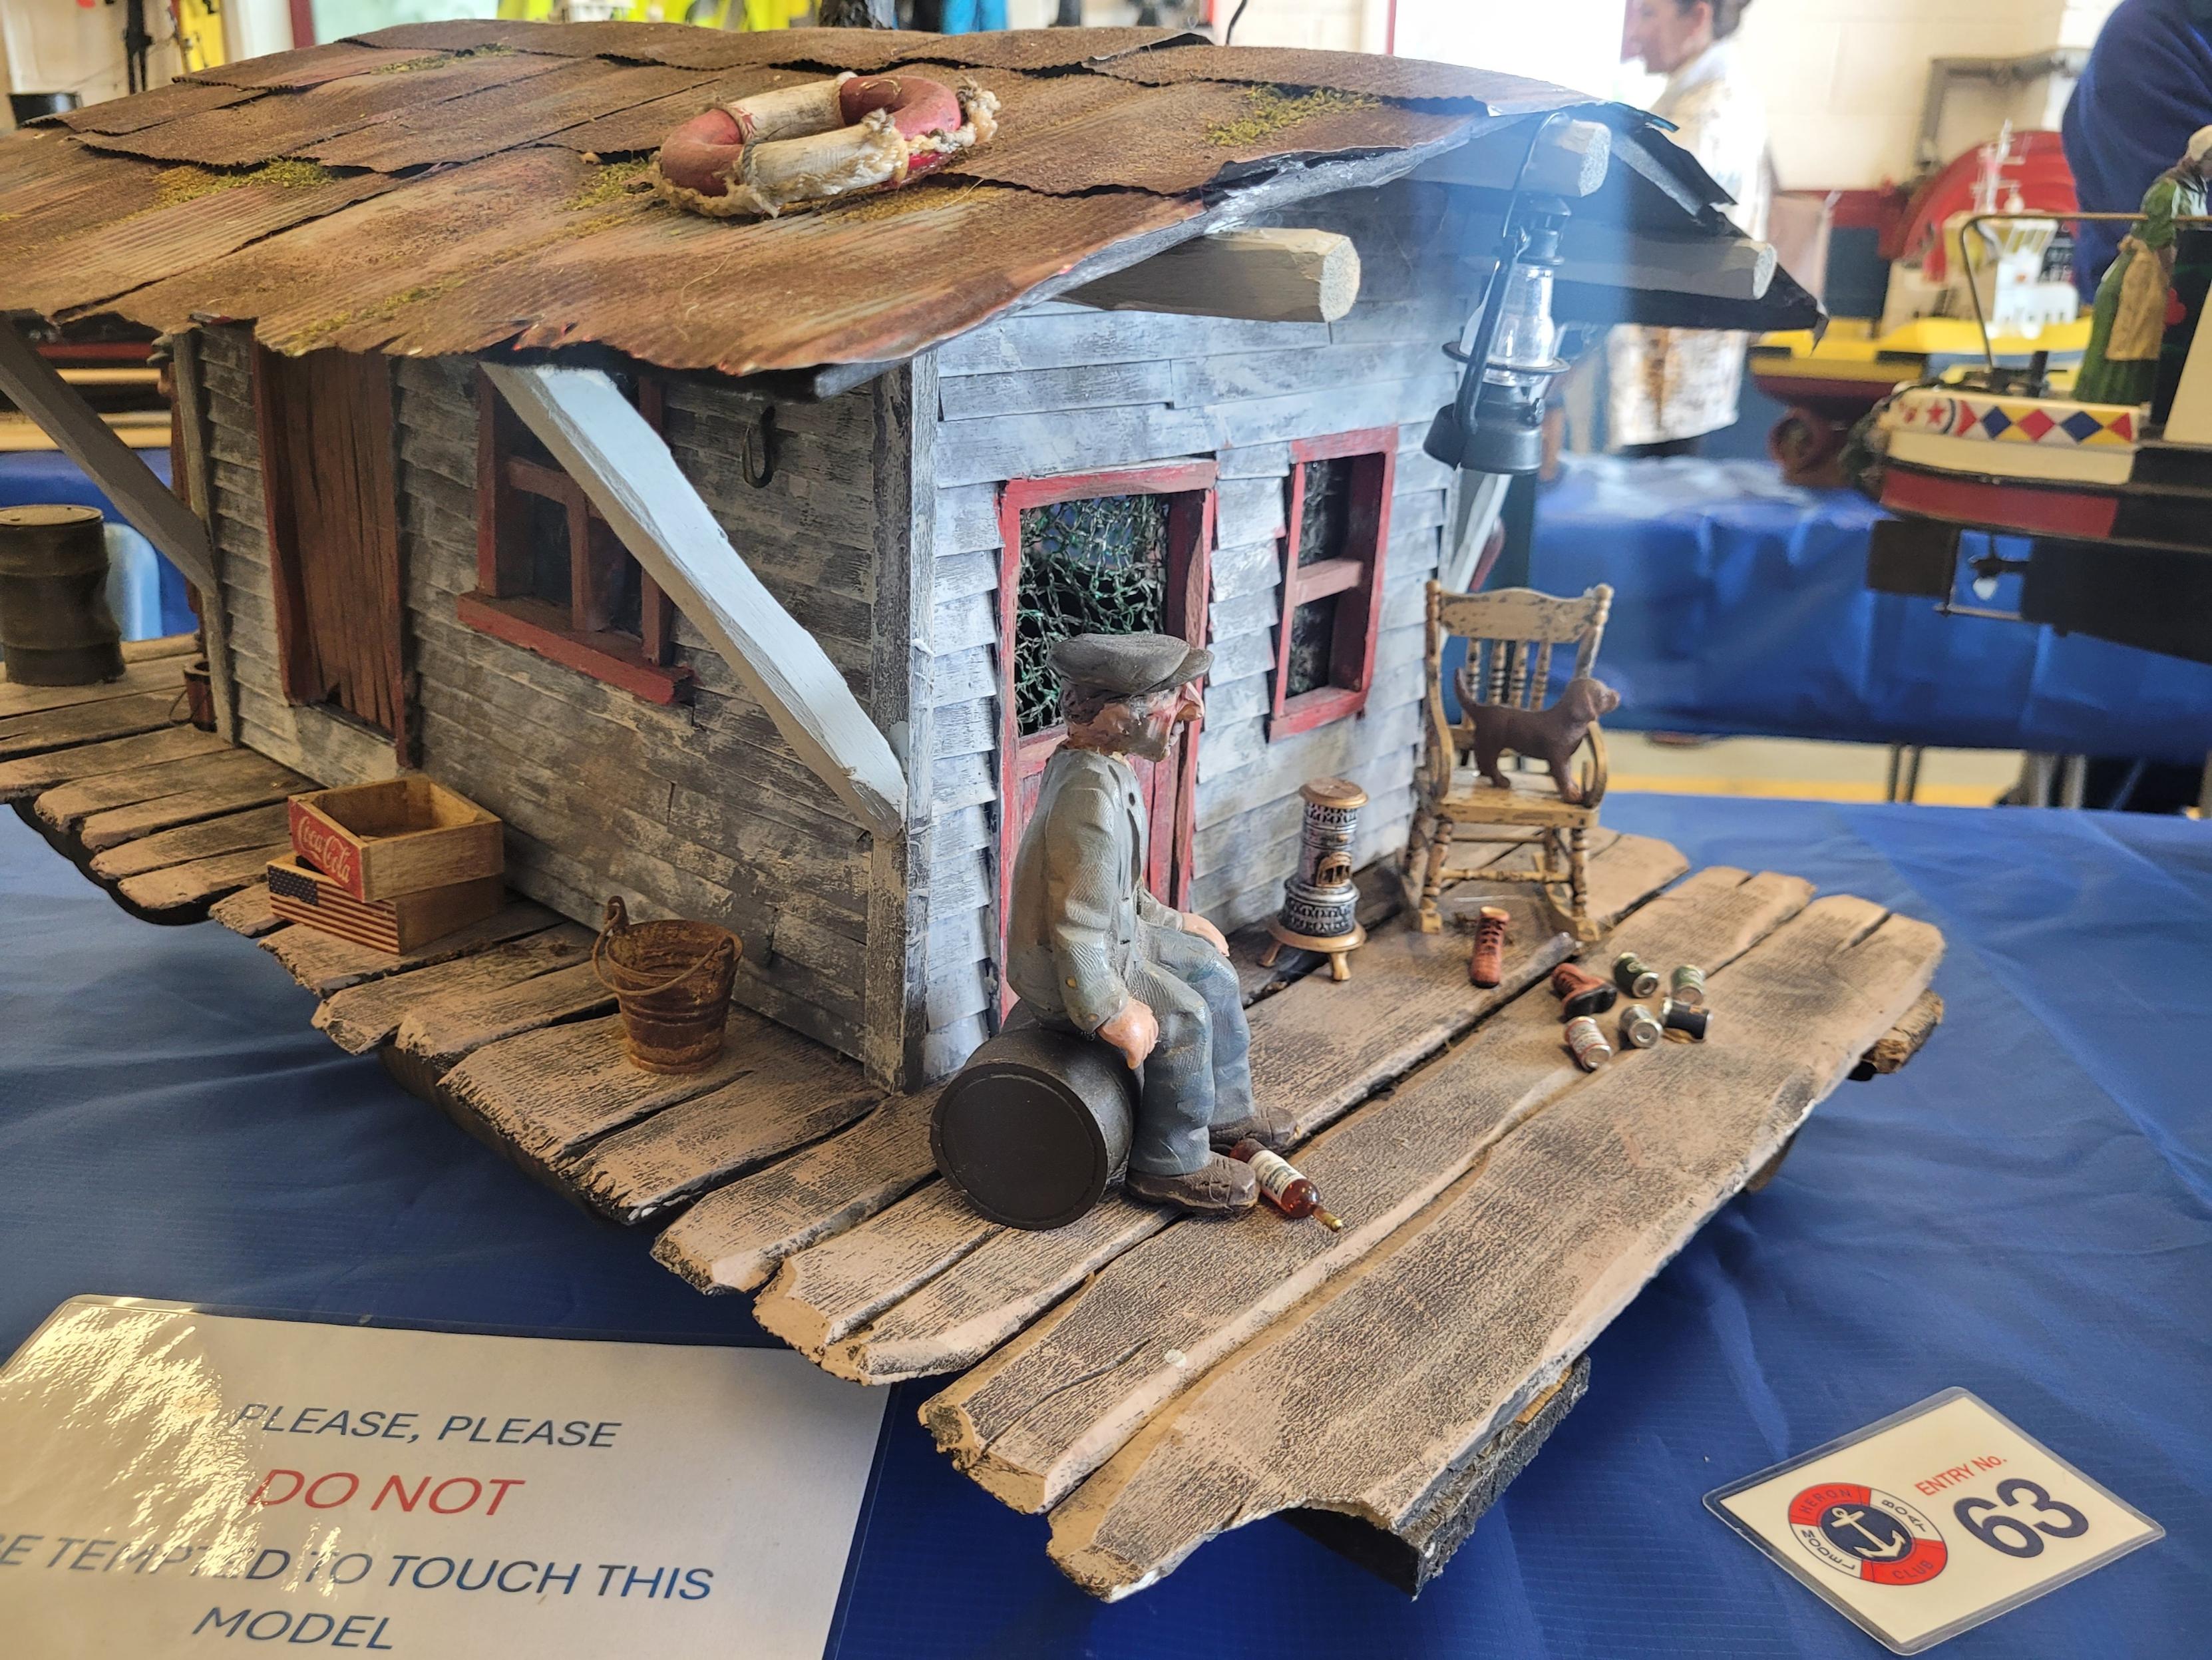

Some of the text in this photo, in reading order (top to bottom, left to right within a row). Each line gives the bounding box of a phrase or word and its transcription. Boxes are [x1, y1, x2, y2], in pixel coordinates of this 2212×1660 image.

[230, 1403, 622, 1447] PLEASE, PLEASE
[247, 1469, 526, 1516] DO NOT
[1915, 1456, 2008, 1496] ENTRY No.
[1799, 1488, 1934, 1579] HERON MODEL BOAT CLUB
[1953, 1478, 2089, 1559] 63
[0, 1534, 44, 1565] E
[389, 1555, 582, 1595] TOUCH
[598, 1564, 714, 1600] THIS
[192, 1606, 393, 1650] MODEL
